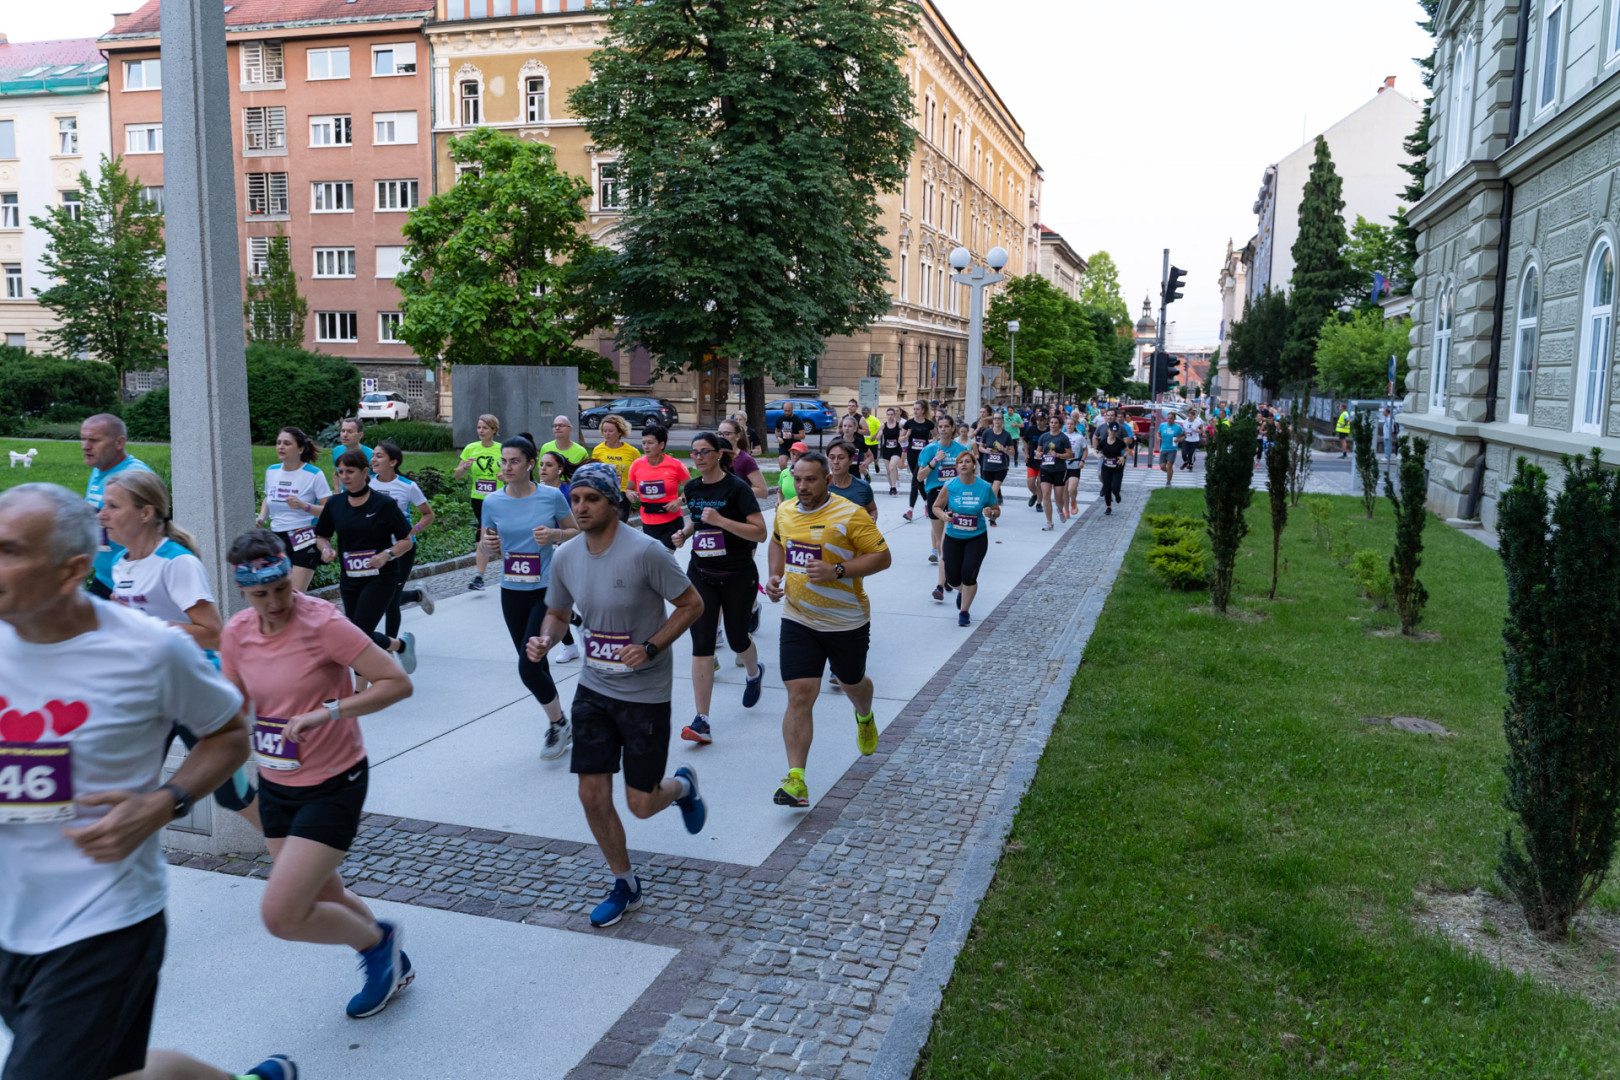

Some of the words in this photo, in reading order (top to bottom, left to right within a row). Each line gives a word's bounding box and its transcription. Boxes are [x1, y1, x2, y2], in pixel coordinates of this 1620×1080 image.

[941, 469, 955, 477] 192
[478, 483, 493, 491] 216
[645, 485, 659, 495] 59
[958, 517, 973, 526] 131
[295, 529, 316, 544] 251
[698, 537, 716, 549] 45
[511, 560, 531, 574] 46
[589, 640, 624, 661] 247
[255, 730, 284, 755] 147
[0, 765, 57, 800] 46
